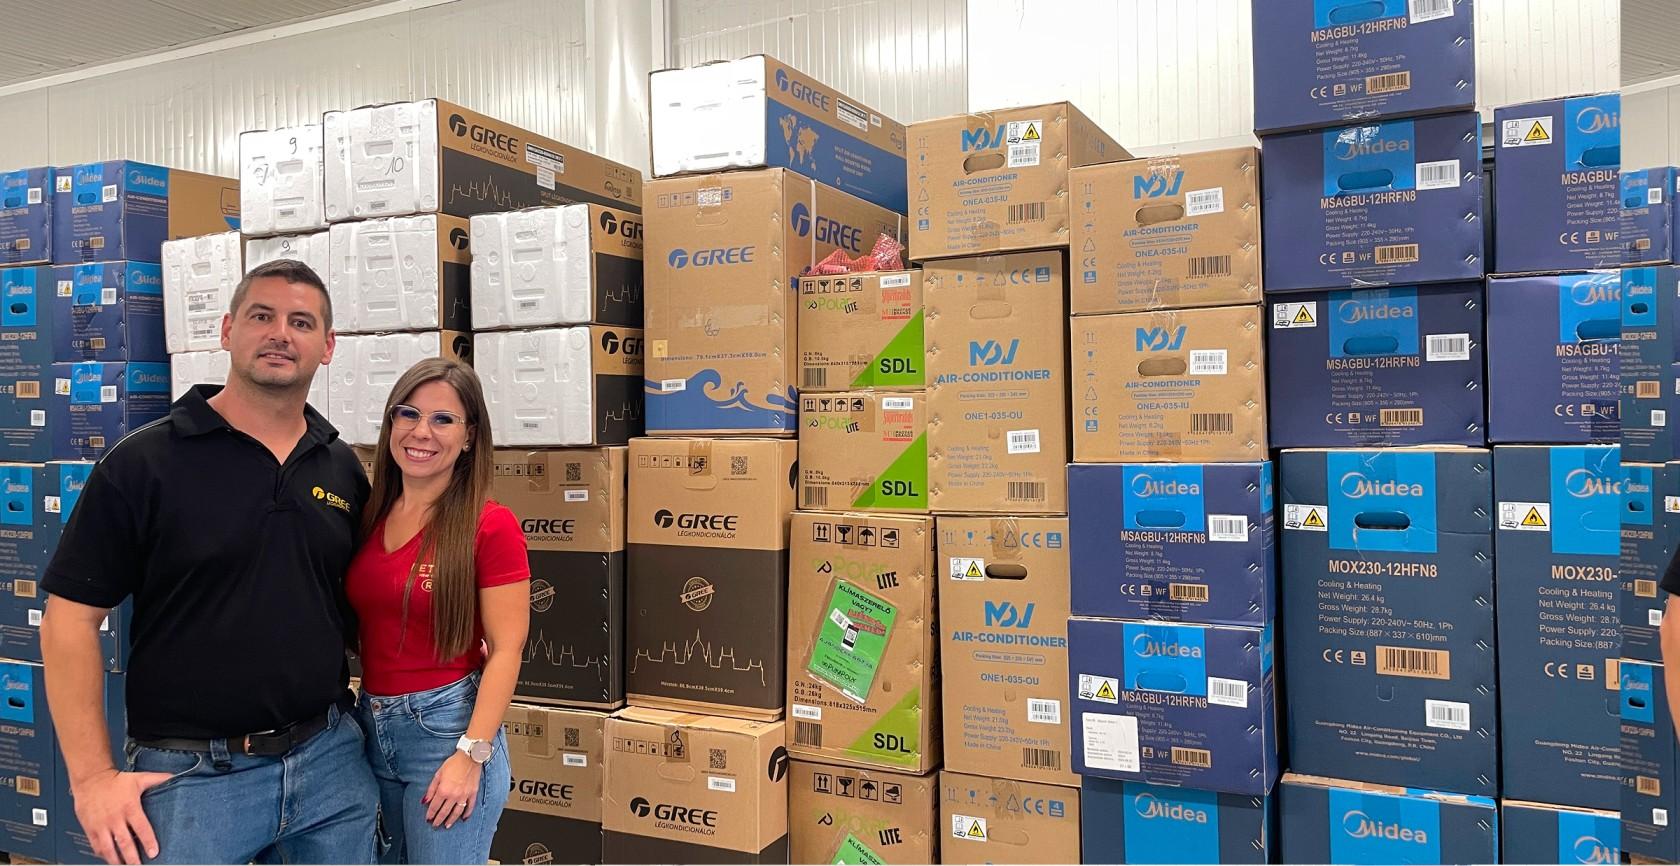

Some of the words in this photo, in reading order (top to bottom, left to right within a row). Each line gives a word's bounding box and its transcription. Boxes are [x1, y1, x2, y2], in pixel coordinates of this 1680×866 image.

[1311, 17, 1408, 43] MSAGBU-12HRFN8
[791, 80, 831, 112] GREE
[1311, 86, 1327, 98] CE
[1350, 84, 1363, 92] WF
[1576, 107, 1620, 133] Mi
[471, 125, 519, 154] GREE
[962, 125, 1006, 152] MDV
[1334, 138, 1410, 160] Midea
[385, 157, 404, 175] 10
[128, 170, 166, 188] Midea
[952, 173, 1018, 187] AIR-CONDITIONER
[1133, 171, 1185, 199] MDV
[1320, 191, 1417, 208] MSAGBU-12HRFN8
[815, 217, 863, 252] GREE
[1123, 223, 1199, 237] AIR-CONDITIONER
[1560, 232, 1579, 244] CE
[1605, 232, 1619, 240] WF
[692, 246, 756, 267] GREE
[1320, 253, 1336, 264] CE
[1009, 268, 1030, 284] CE
[844, 301, 859, 314] LITE
[1339, 299, 1414, 324] Midea
[1136, 325, 1187, 351] MDV
[969, 338, 1020, 366] MDV
[1556, 344, 1621, 356] MSAGBU-1
[880, 358, 917, 374] SDL
[1326, 356, 1420, 370] MSAGBU-12HRFN8
[937, 369, 1050, 384] AIR-CONDITIONER
[1125, 379, 1201, 388] AIR-CONDITIONER
[1137, 402, 1190, 411] ONEA-035-IU
[1555, 404, 1574, 416] CE
[1601, 406, 1615, 414] WF
[964, 411, 1023, 421] ONE1-035-OU
[1326, 413, 1342, 424] CE
[845, 421, 860, 433] LITE
[881, 480, 919, 497] SDL
[1131, 473, 1200, 498] Midea
[1341, 472, 1423, 498] Midea
[326, 492, 351, 512] GREE
[521, 518, 576, 534] GREE
[678, 513, 738, 531] GREE
[525, 534, 574, 542] GKONDICIONÁLÓK
[677, 529, 737, 540] LÉGKONDICIONÁLÓK
[1021, 532, 1041, 548] CE
[1120, 531, 1206, 544] MSAGBU-12HRFN8
[1328, 560, 1438, 578] MOX230-12HFN8
[1551, 565, 1618, 581] MOX230-
[876, 571, 899, 590] LITE
[1318, 579, 1344, 590] Cooling
[1354, 581, 1382, 591] Heating
[1120, 583, 1136, 595] CE
[1538, 586, 1570, 597] Cooling
[1580, 589, 1613, 600] Heating
[838, 584, 892, 614] KLÍMASZERELŐ
[1318, 591, 1331, 599] Net
[1376, 595, 1385, 604] kg
[1318, 603, 1340, 611] Gross
[1371, 606, 1393, 616] 28.7kg
[1538, 600, 1554, 608] Net
[1606, 604, 1616, 612] kg
[985, 601, 1035, 628] MDV
[1319, 614, 1341, 622] Power
[1438, 622, 1453, 630] 1Ph
[1539, 612, 1564, 621] Gross
[1319, 625, 1347, 636] Packing
[1392, 630, 1406, 639] 337
[1415, 632, 1447, 642] 610)mm
[1539, 625, 1566, 634] Power
[952, 632, 1067, 648] AIR-CONDITIONER
[1133, 633, 1202, 659] Midea
[1540, 637, 1573, 648] Packing
[1323, 648, 1344, 663] CE
[1544, 662, 1568, 678] CE
[980, 673, 1040, 685] ONE1-035-OU
[1121, 691, 1208, 709] MSAGBU-12HRFN8
[873, 733, 911, 753] SDL
[1157, 751, 1169, 759] WF
[519, 779, 574, 801] GREE
[1023, 797, 1044, 815] CE
[1134, 792, 1208, 825] Midea
[654, 804, 718, 828] GREE
[654, 820, 716, 836] LÉGKONDICIONÁLÓK
[1342, 810, 1428, 845] Midea
[878, 828, 903, 846] LITE
